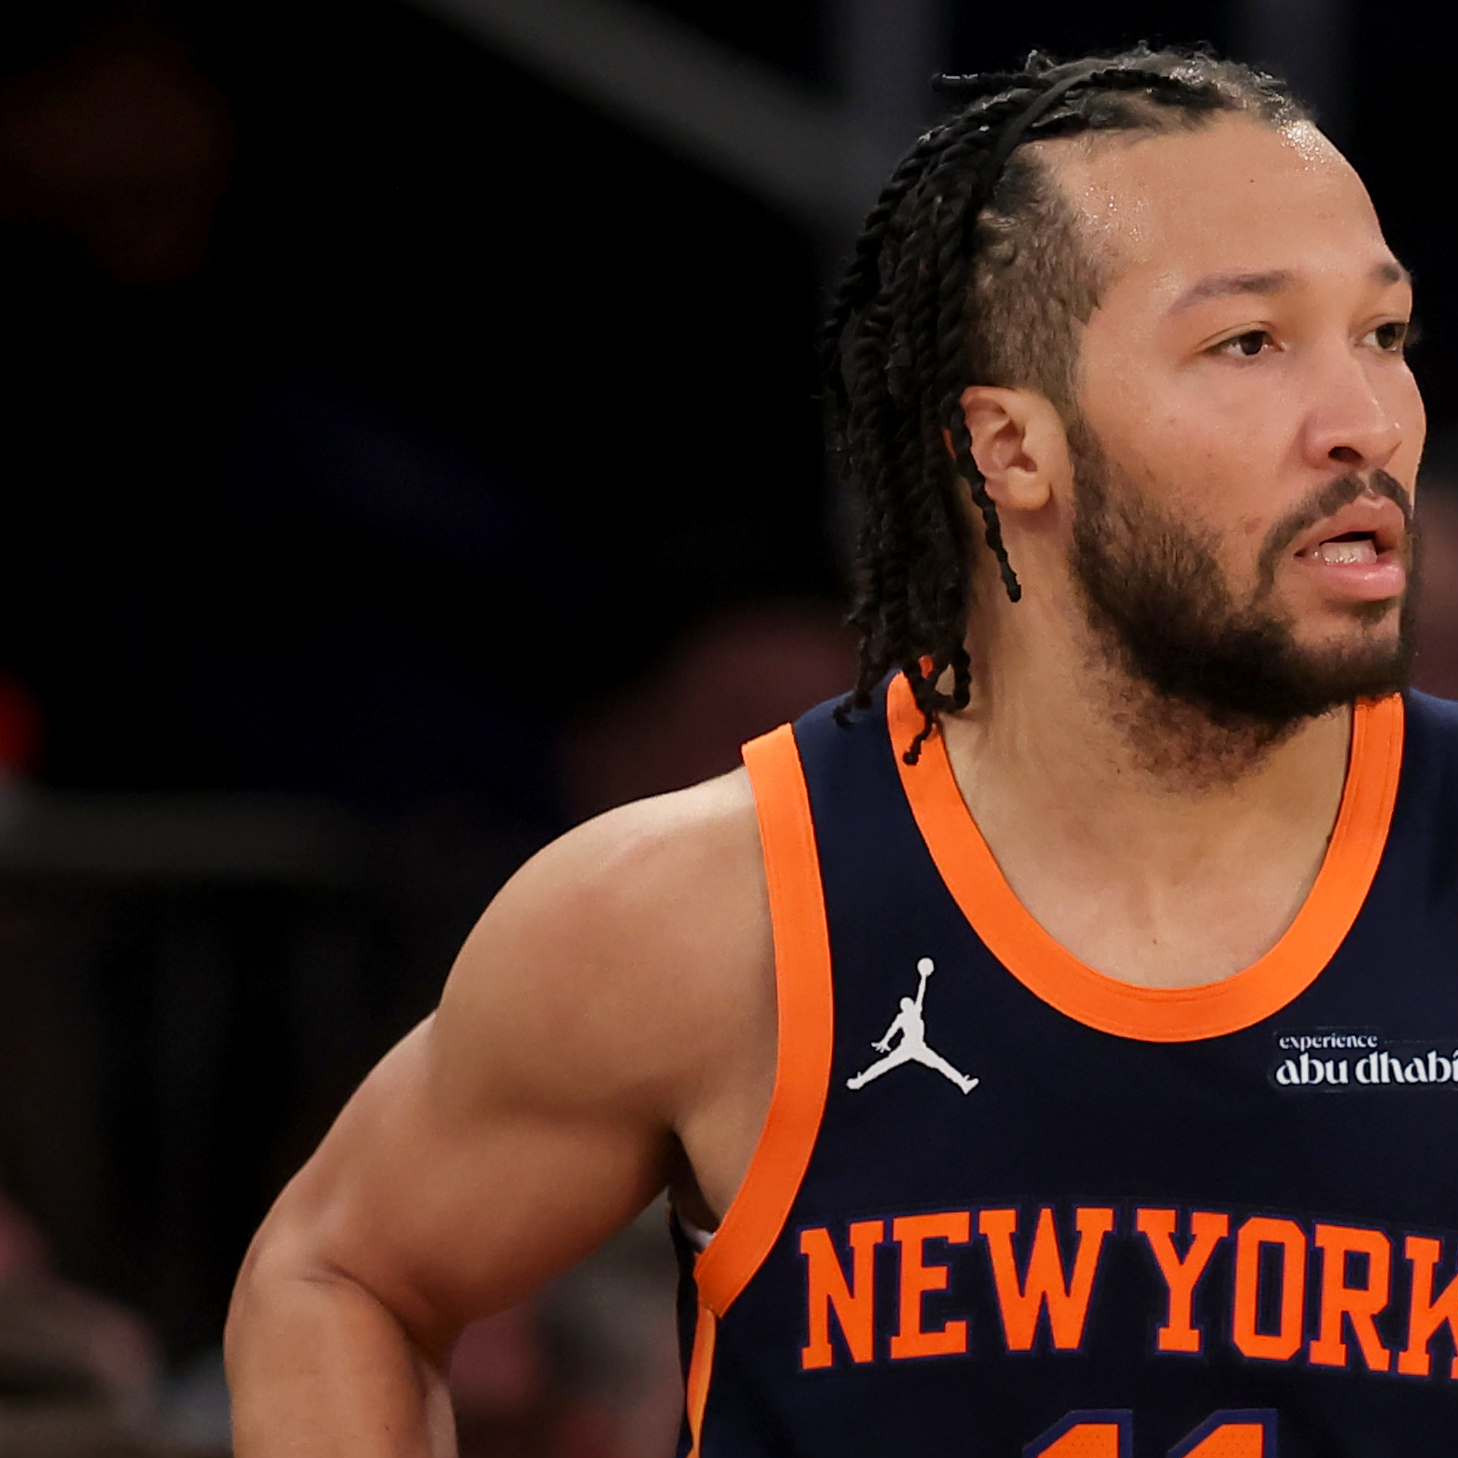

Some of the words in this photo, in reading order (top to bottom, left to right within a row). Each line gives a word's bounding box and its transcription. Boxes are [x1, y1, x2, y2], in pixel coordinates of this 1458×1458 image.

[1279, 1031, 1378, 1052] experience
[1275, 1051, 1349, 1085] abu
[800, 1206, 1115, 1370] NEW
